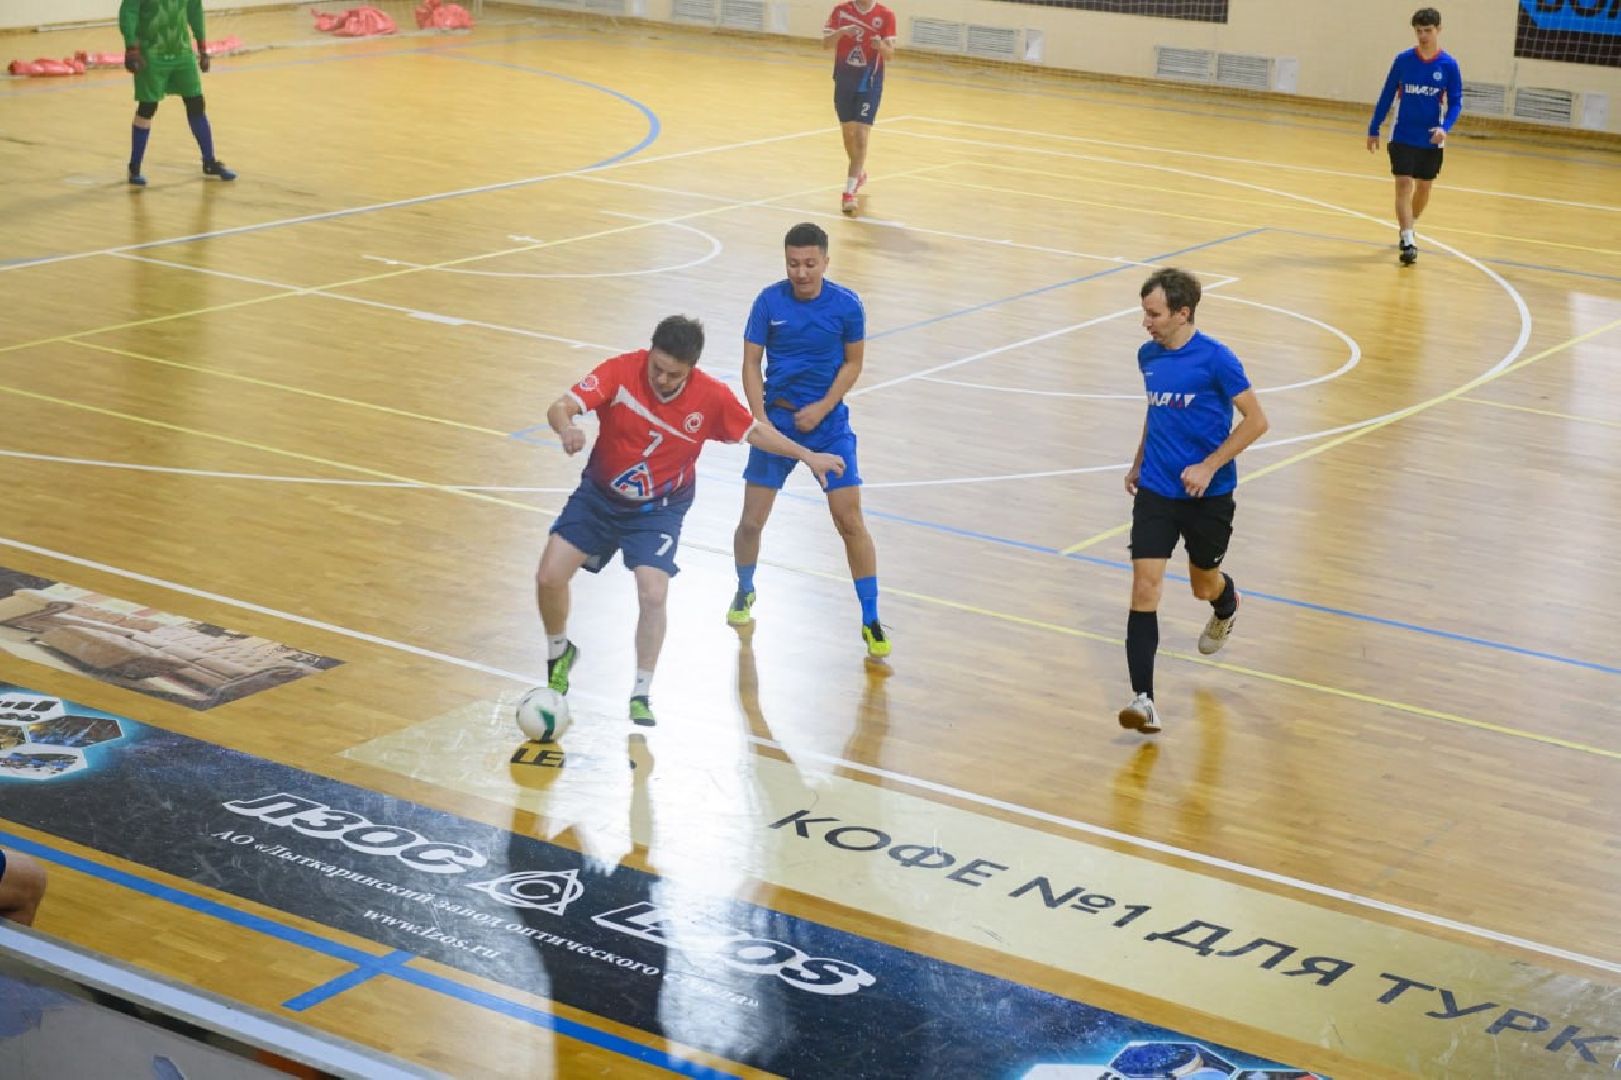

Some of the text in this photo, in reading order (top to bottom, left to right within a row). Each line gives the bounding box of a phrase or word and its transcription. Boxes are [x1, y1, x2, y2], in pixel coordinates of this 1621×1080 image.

[861, 102, 871, 117] 2
[642, 430, 664, 458] 7
[655, 533, 674, 556] 7
[222, 792, 488, 875] ЛЗОС
[211, 830, 255, 845] АО
[505, 923, 660, 976] оптического
[768, 808, 1009, 887] КОФЕ
[1143, 919, 1356, 986] ДЛЯ
[364, 910, 502, 959] www.lzos.ru
